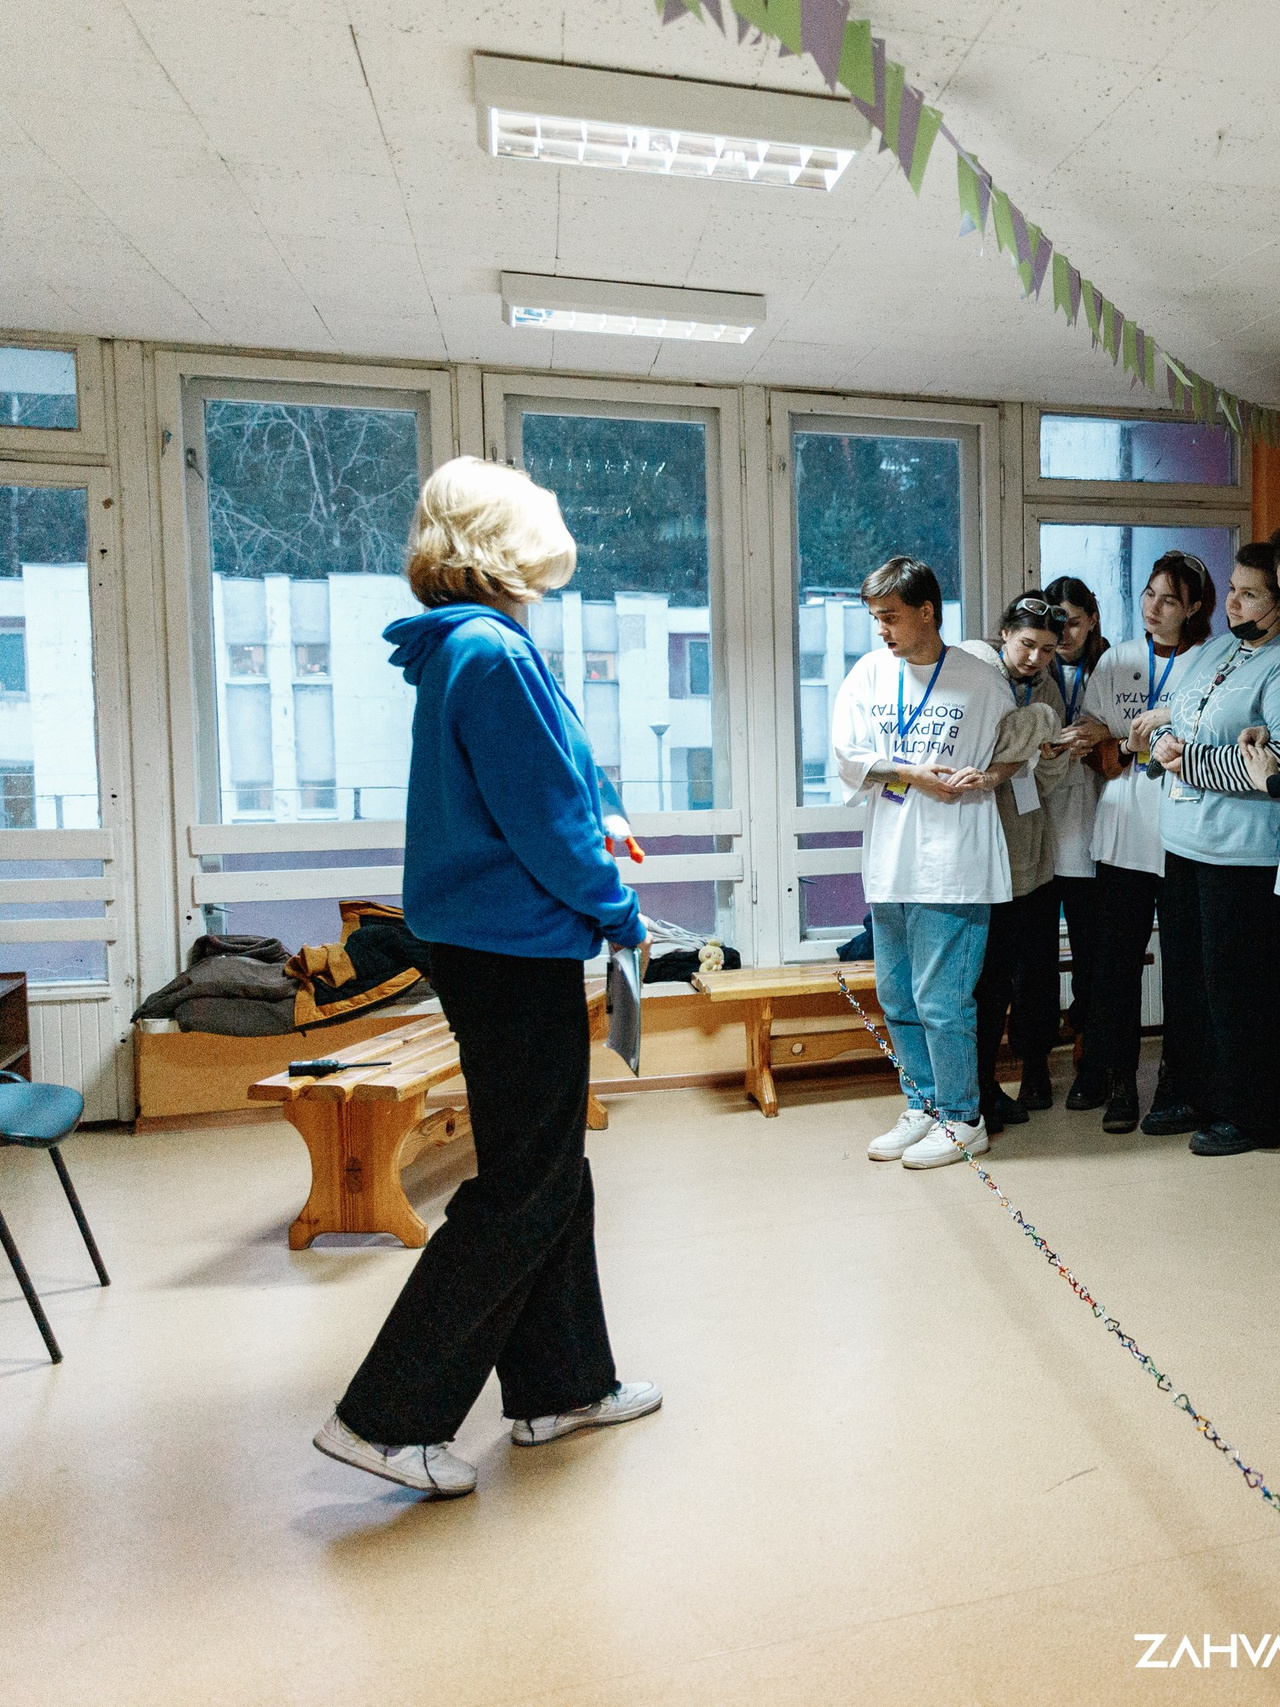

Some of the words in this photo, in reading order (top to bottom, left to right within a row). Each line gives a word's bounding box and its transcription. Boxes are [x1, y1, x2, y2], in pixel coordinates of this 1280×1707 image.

[878, 721, 945, 736] ДРУИХ
[948, 725, 960, 739] В
[894, 740, 955, 757] МЫСЛИ
